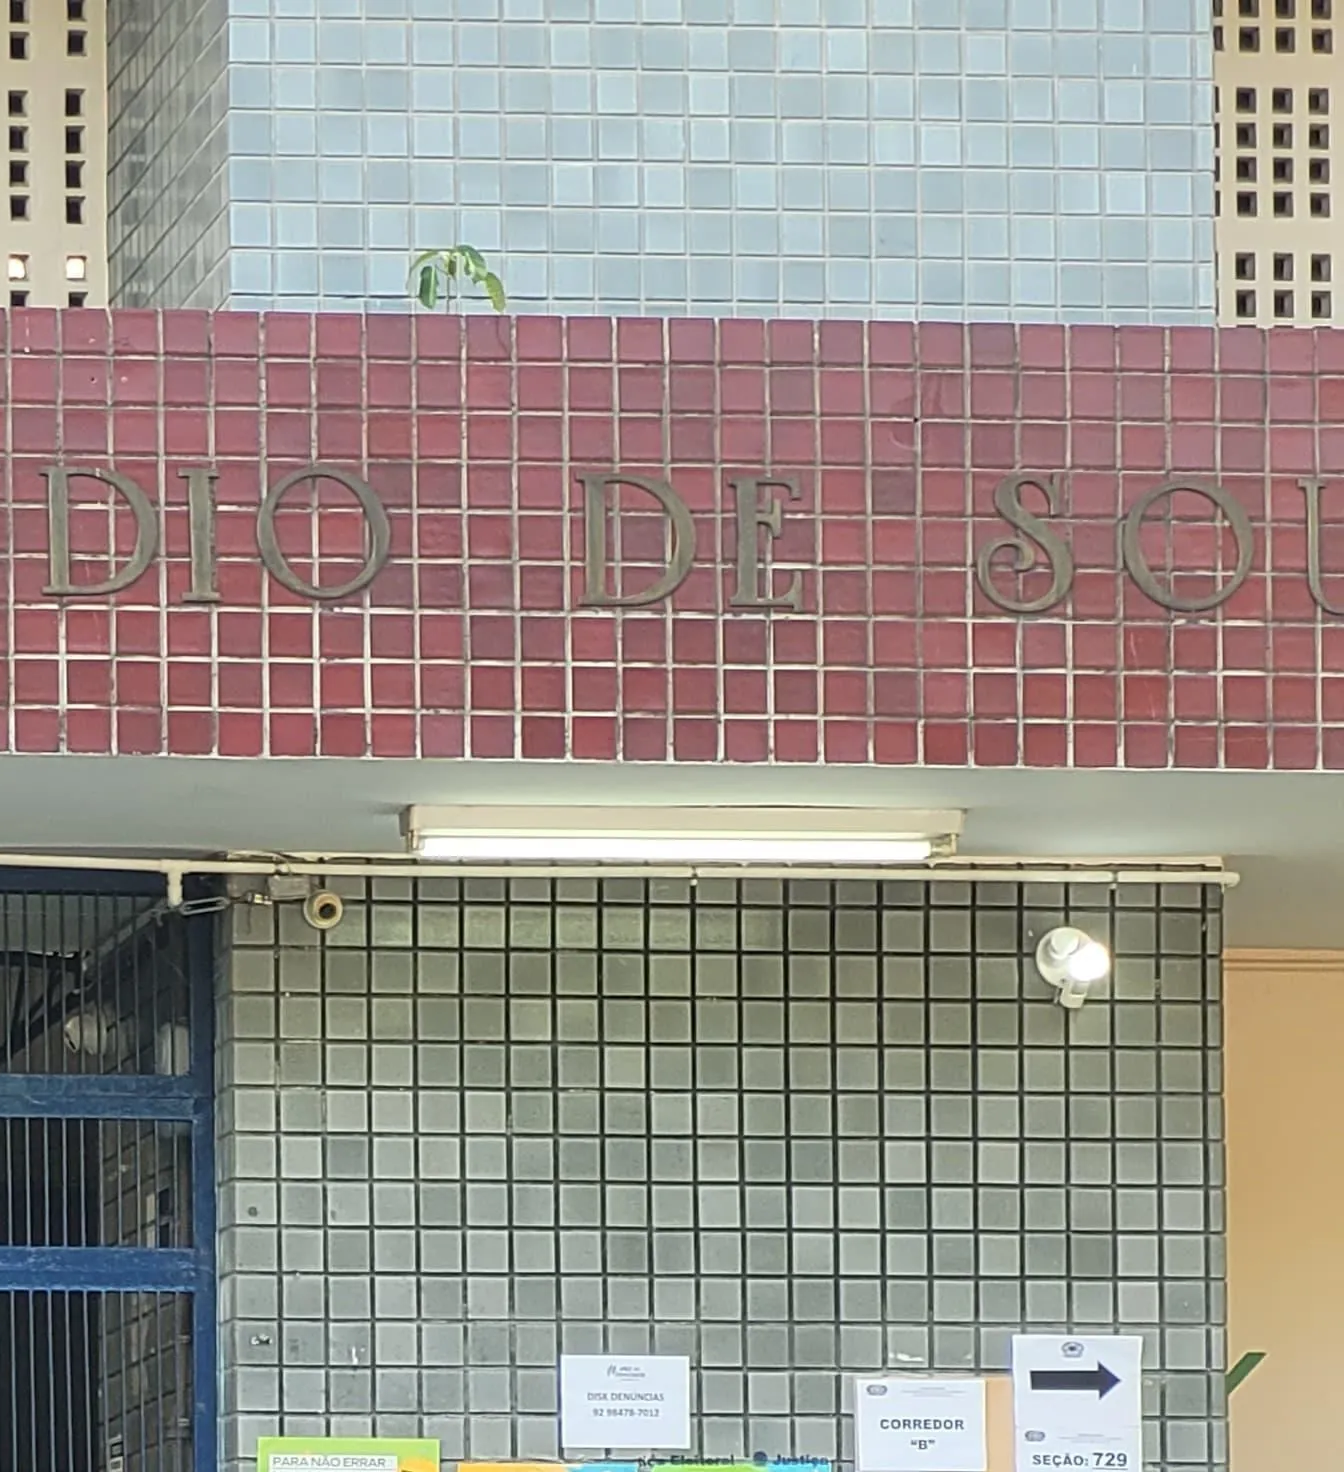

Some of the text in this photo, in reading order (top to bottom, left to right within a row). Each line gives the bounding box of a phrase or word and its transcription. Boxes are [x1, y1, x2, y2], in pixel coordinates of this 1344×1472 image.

[574, 470, 806, 612] DE
[880, 1418, 965, 1431] CORREDOR
[272, 1455, 386, 1467] PARA NÃO ERRAR
[1032, 1453, 1128, 1467] SEÇÃO: 729
